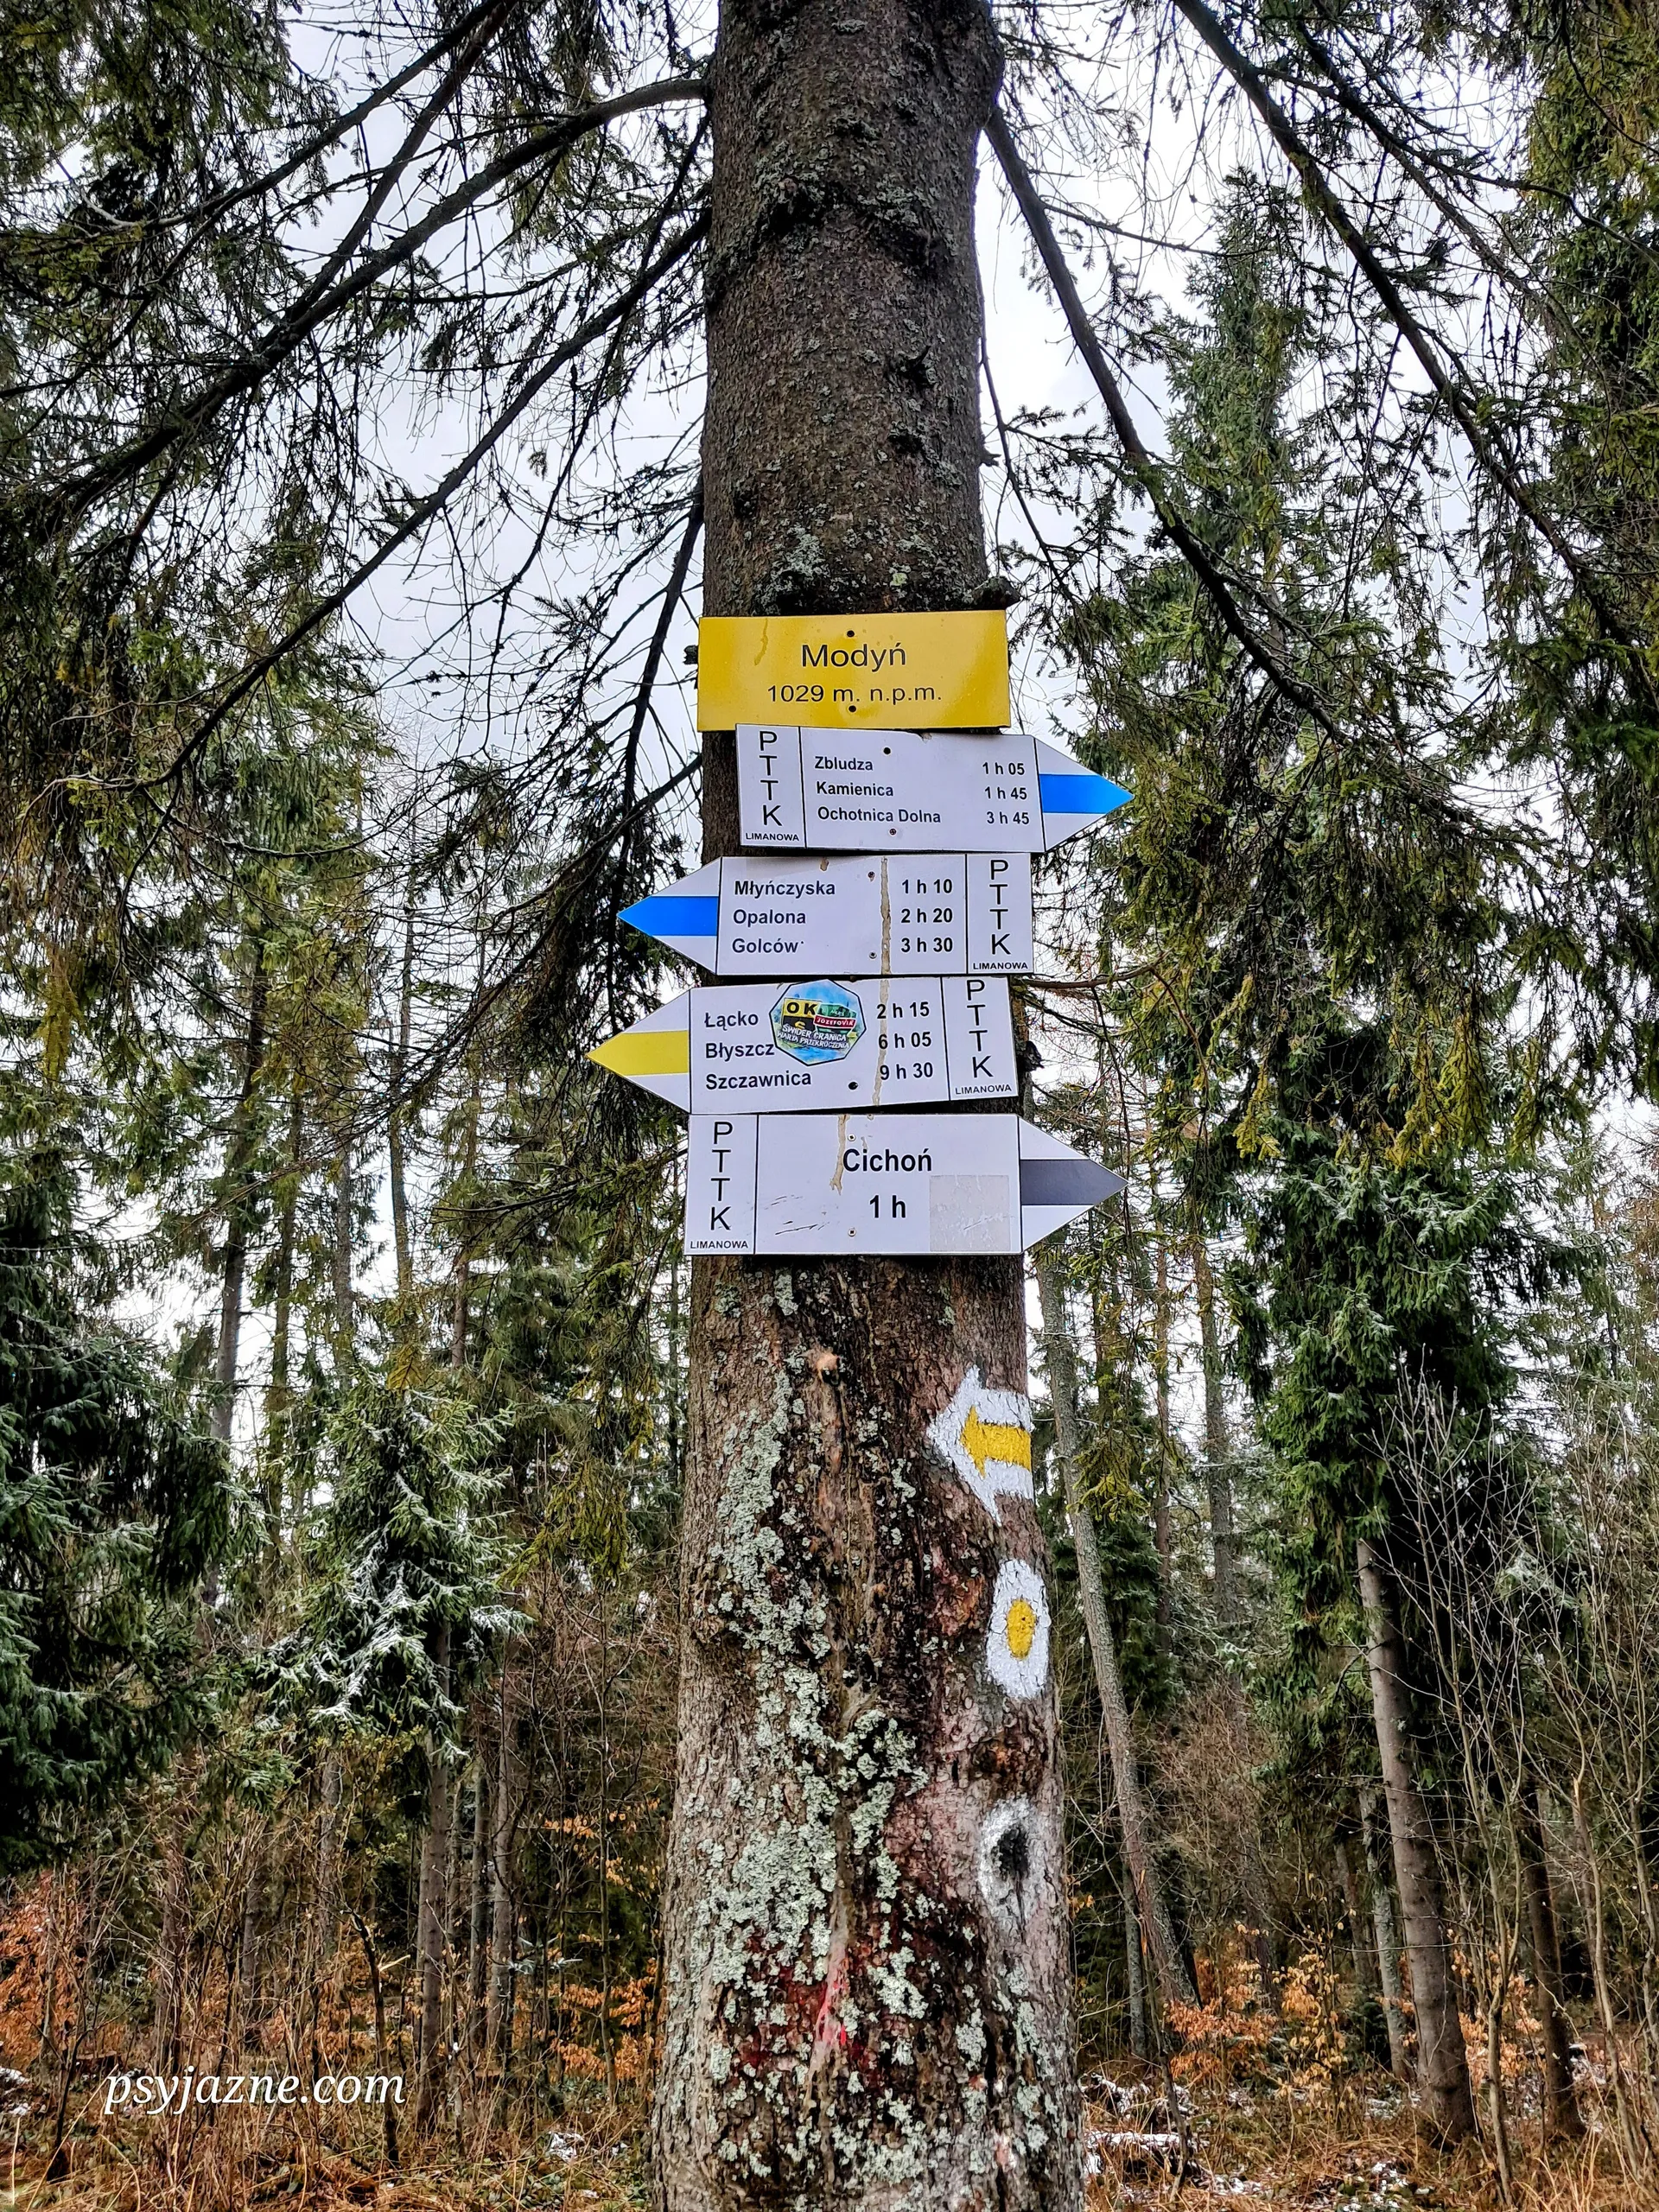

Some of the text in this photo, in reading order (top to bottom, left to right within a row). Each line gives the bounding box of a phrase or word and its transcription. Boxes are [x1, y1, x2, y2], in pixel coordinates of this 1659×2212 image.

[803, 643, 905, 672] Modyń
[768, 685, 941, 705] 1029 m. n.p.m.
[815, 756, 873, 770] Zbludza
[982, 762, 1025, 775] 1 h 05
[760, 731, 782, 826] PTTK
[817, 781, 893, 796] Kamienica
[985, 787, 1027, 799] 1 h 45
[818, 807, 940, 823] Ochotnica Dolna
[987, 811, 1029, 824] 3 h 45
[735, 880, 835, 899] Młyńczyska
[902, 879, 952, 893] 1 h 10
[901, 908, 952, 923] 2 h 20
[989, 860, 1011, 954] PTTK
[734, 910, 805, 927] Opalona
[733, 938, 798, 953] Golców
[901, 938, 952, 952] 3 h 30
[876, 1001, 929, 1020] 2 h 15
[704, 1011, 758, 1031] Łącko
[967, 980, 993, 1077] PTTK
[878, 1032, 931, 1049] 6 h 05
[705, 1041, 775, 1062] Błyszcz
[880, 1063, 932, 1080] 9 h 30
[706, 1071, 810, 1090] Szczawnica
[956, 1084, 1012, 1095] LIMANOWA
[842, 1148, 932, 1173] Cichoń
[711, 1122, 733, 1230] PTTK
[870, 1195, 906, 1217] 1 h
